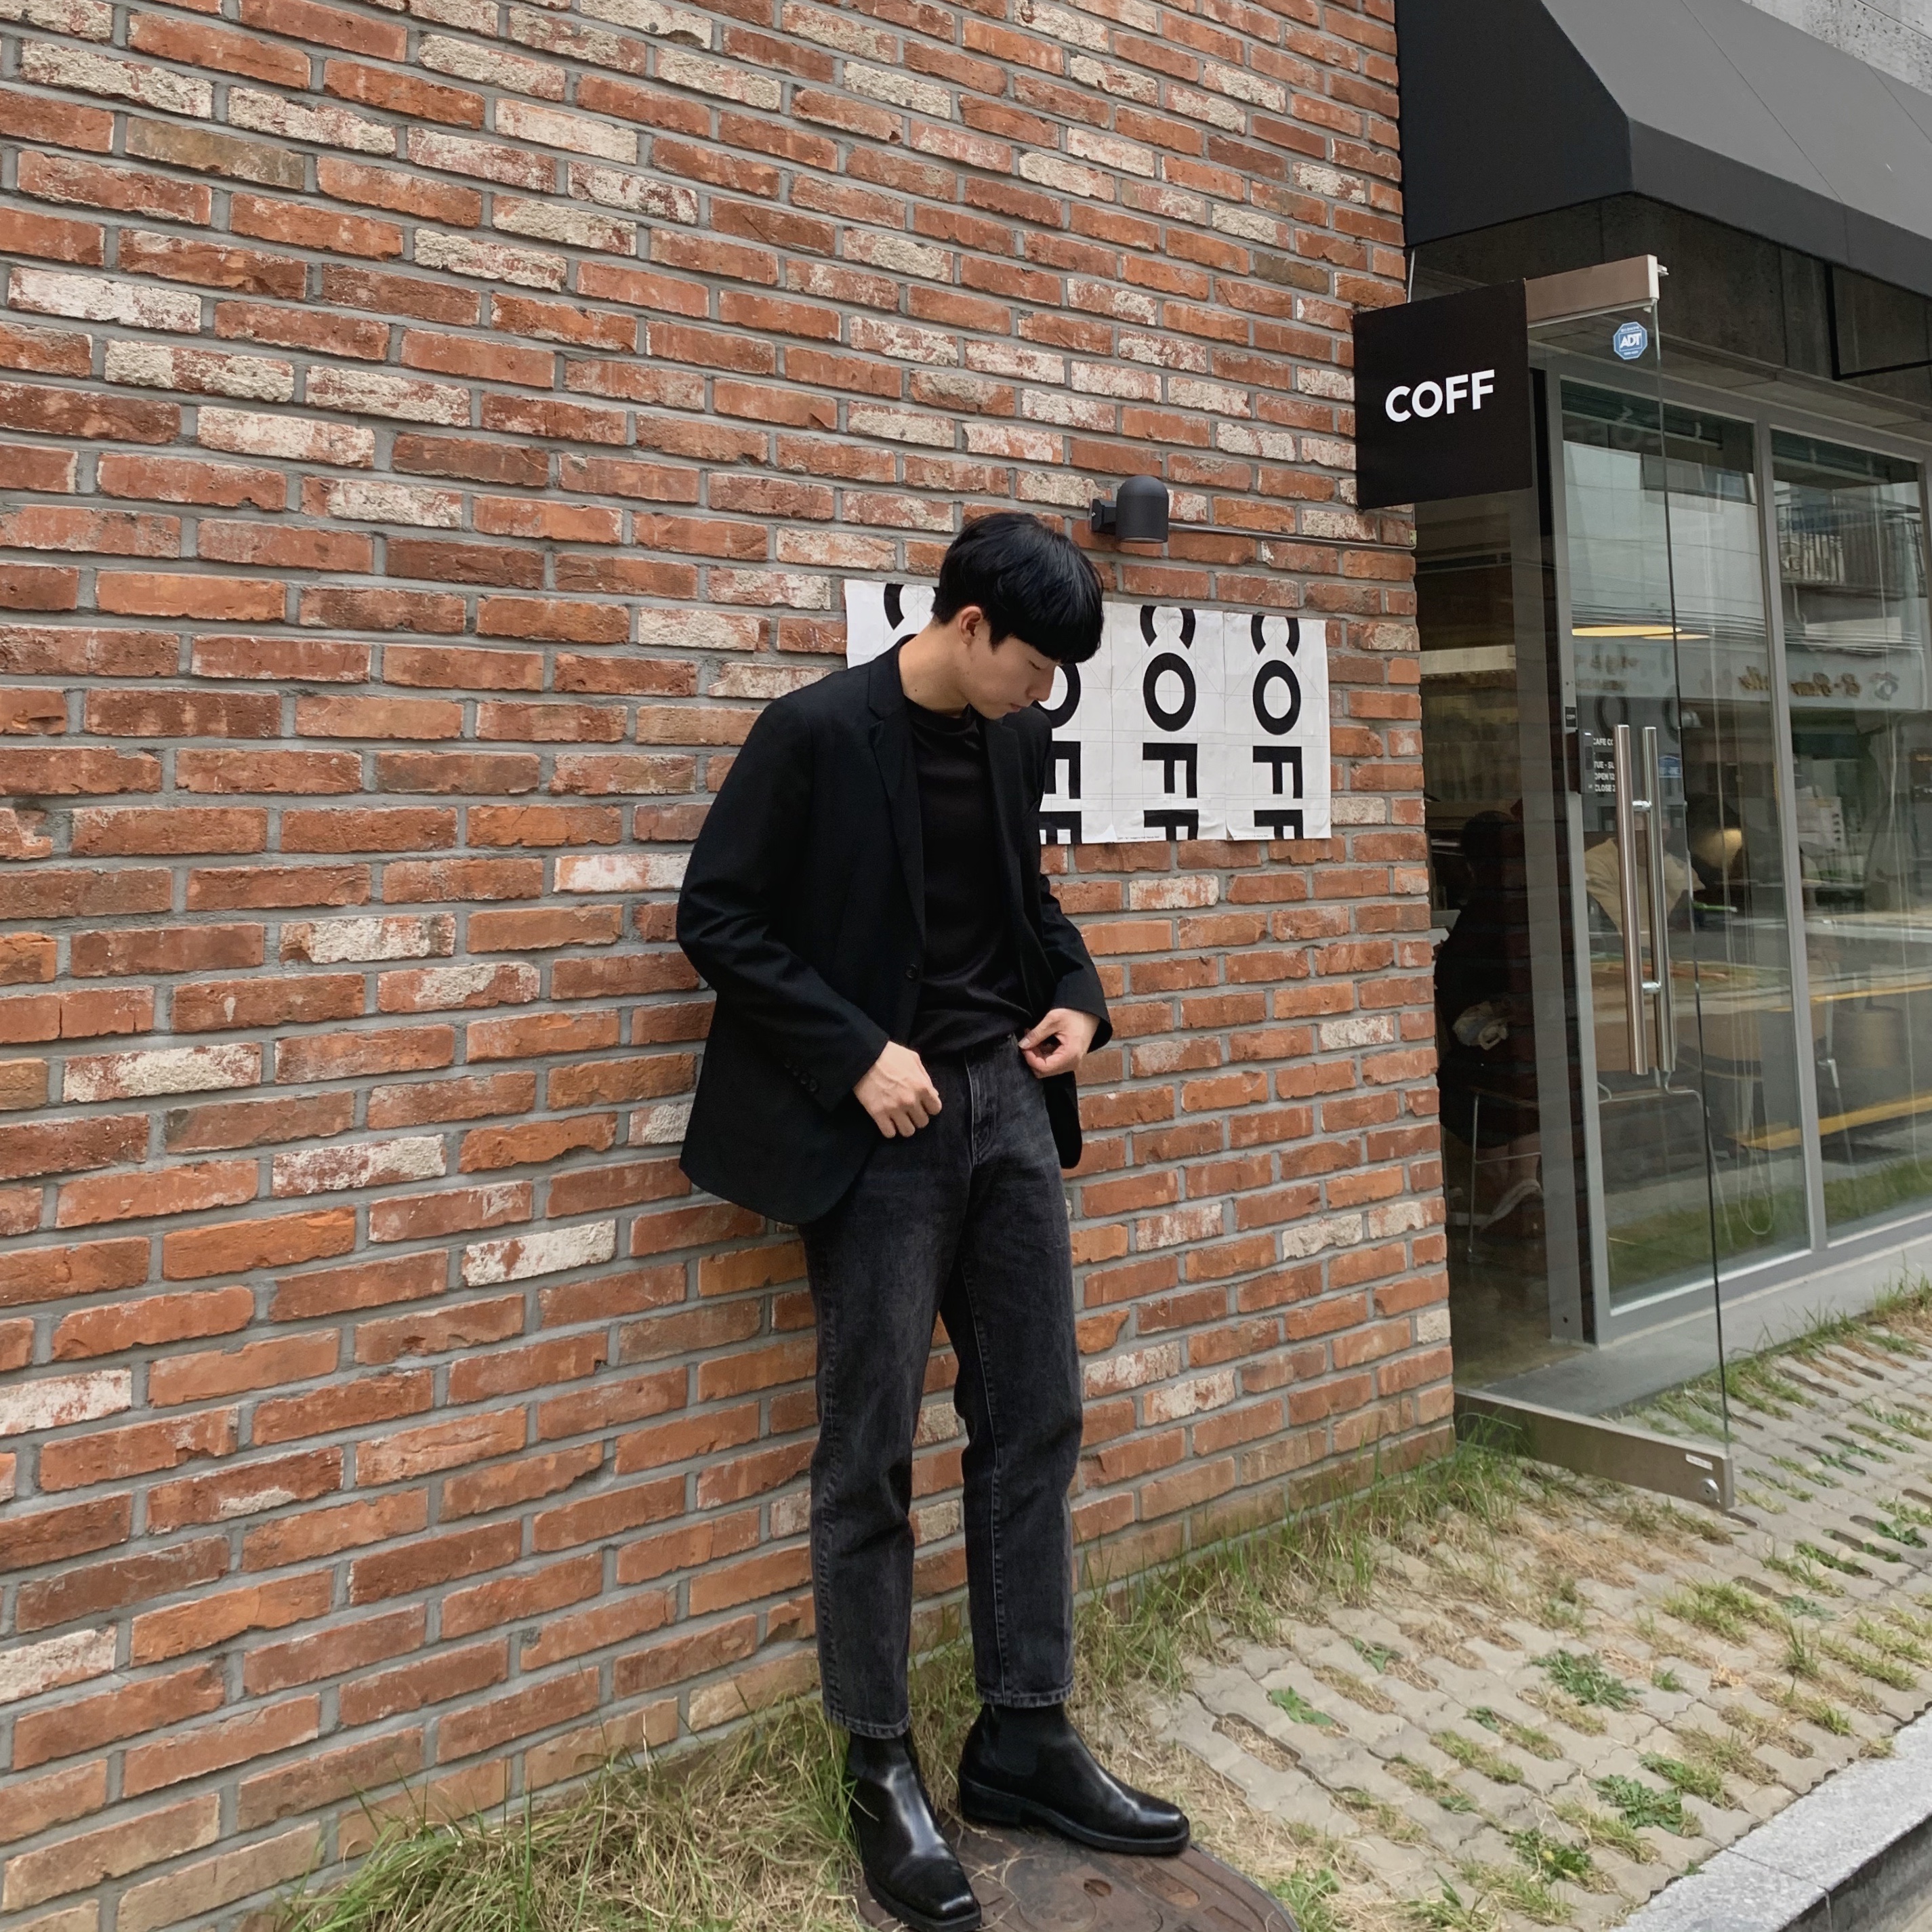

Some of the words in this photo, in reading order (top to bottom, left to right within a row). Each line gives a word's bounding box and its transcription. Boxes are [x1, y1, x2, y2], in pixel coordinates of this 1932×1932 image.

[1620, 333, 1641, 348] ADT
[1386, 369, 1495, 422] COFF
[1595, 784, 1611, 792] CLOSE
